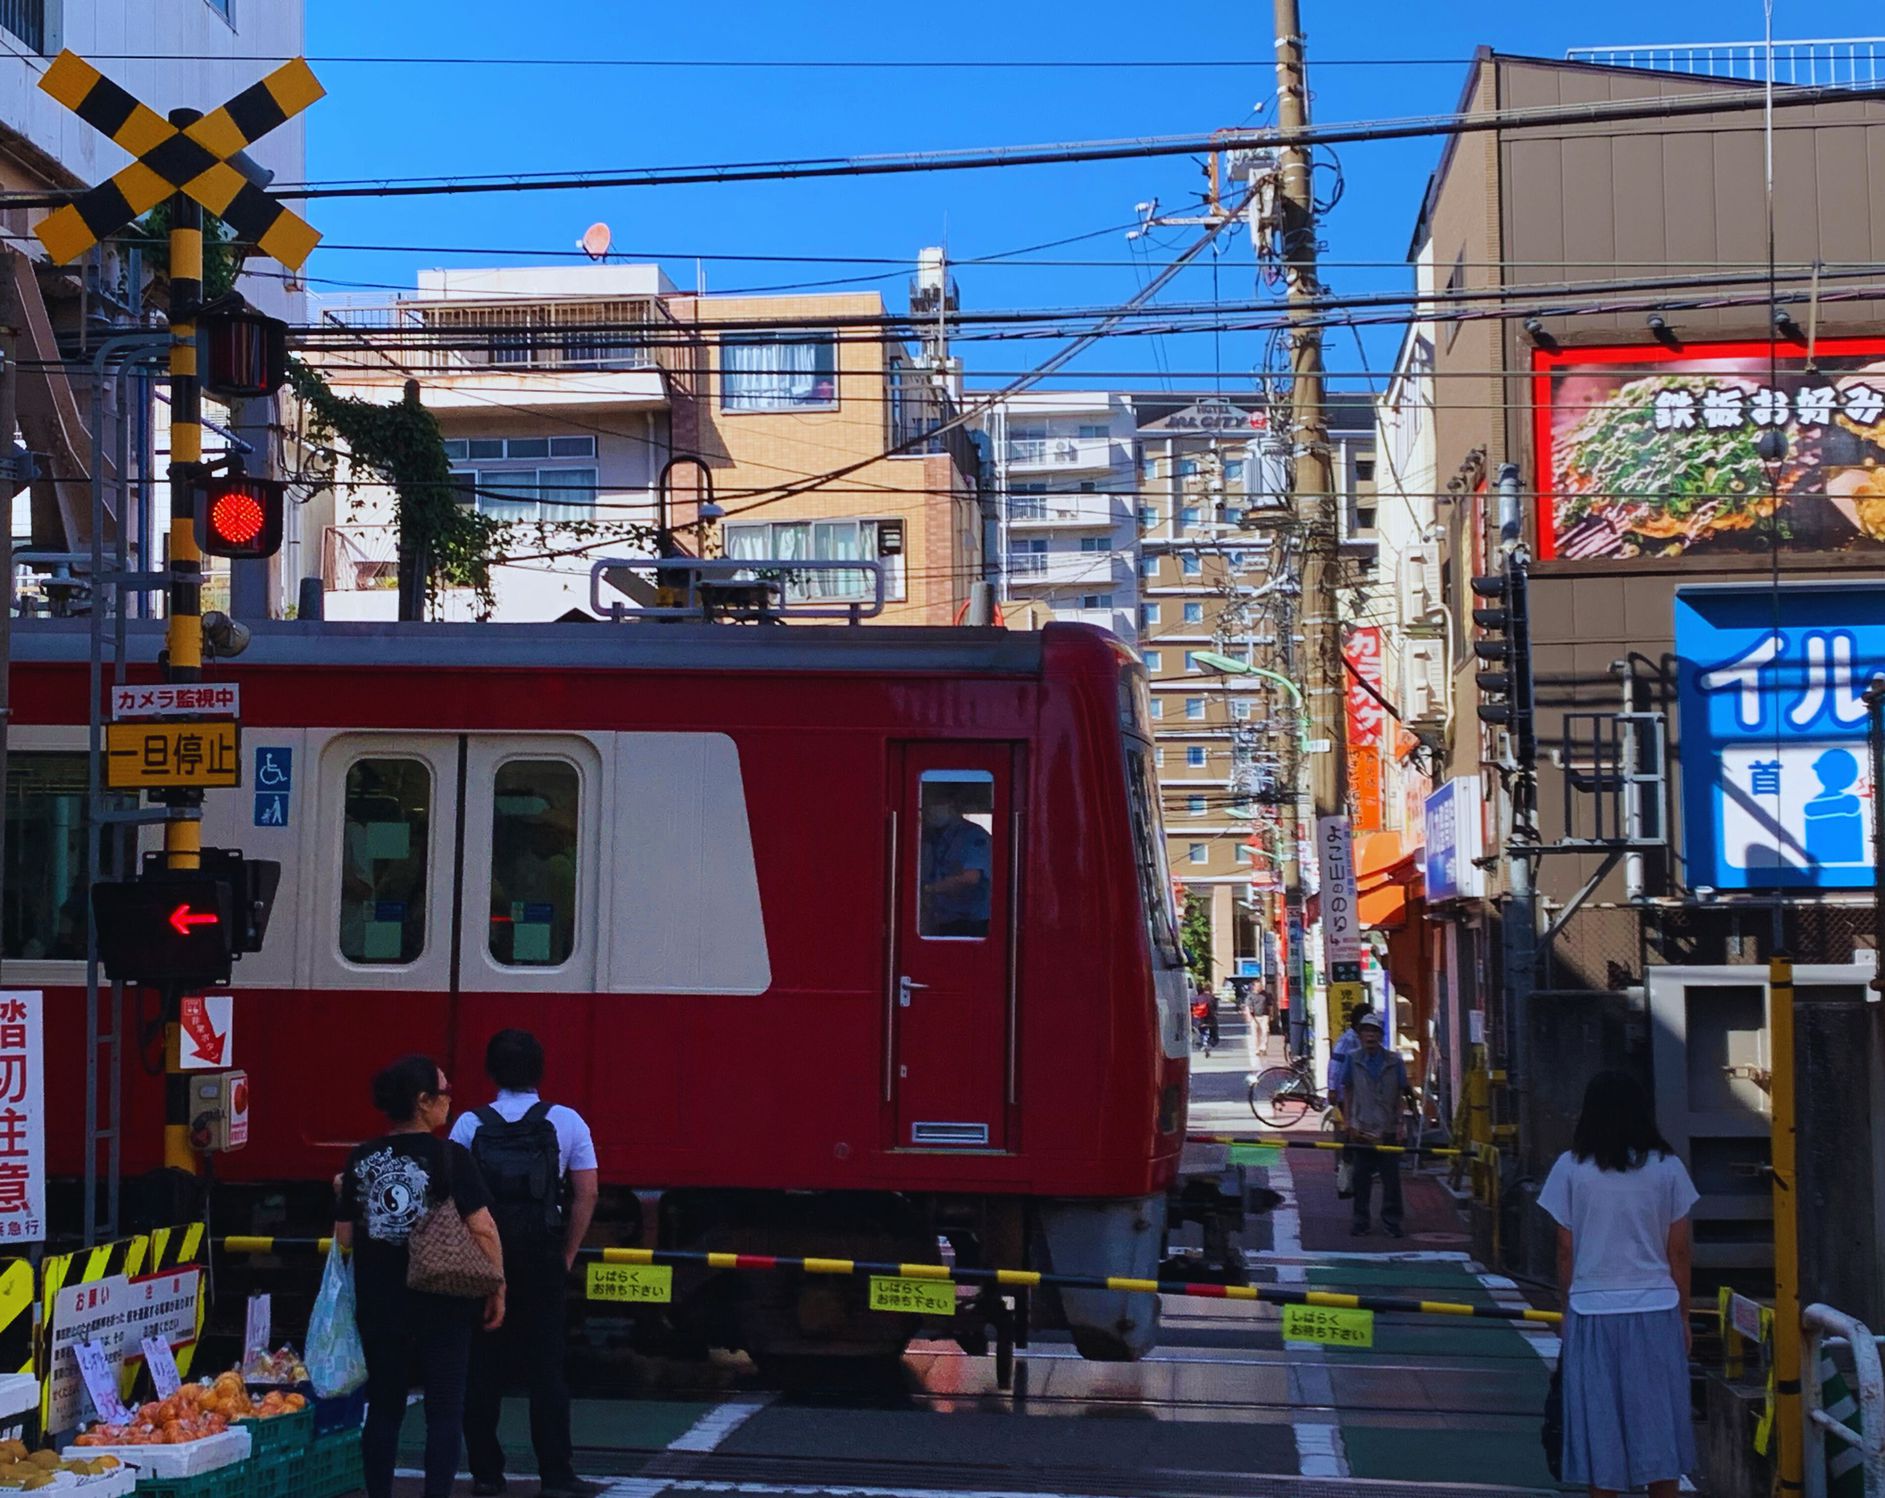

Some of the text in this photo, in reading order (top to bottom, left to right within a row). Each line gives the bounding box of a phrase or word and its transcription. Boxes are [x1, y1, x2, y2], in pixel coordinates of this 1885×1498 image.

[1653, 383, 1885, 431] 鉄板お好み
[118, 688, 235, 710] カメラ監視中
[109, 733, 234, 776] 一旦停止
[1748, 760, 1783, 796] 首
[0, 1219, 39, 1237] 急行
[594, 1270, 640, 1283] しばらく
[592, 1282, 664, 1297] お待ち下さい
[877, 1281, 924, 1295] しばらく
[75, 1286, 110, 1312] お願い
[876, 1294, 949, 1310] お待ち下さい
[1291, 1311, 1339, 1325] しばらく
[1290, 1324, 1365, 1341] お待ち下さい
